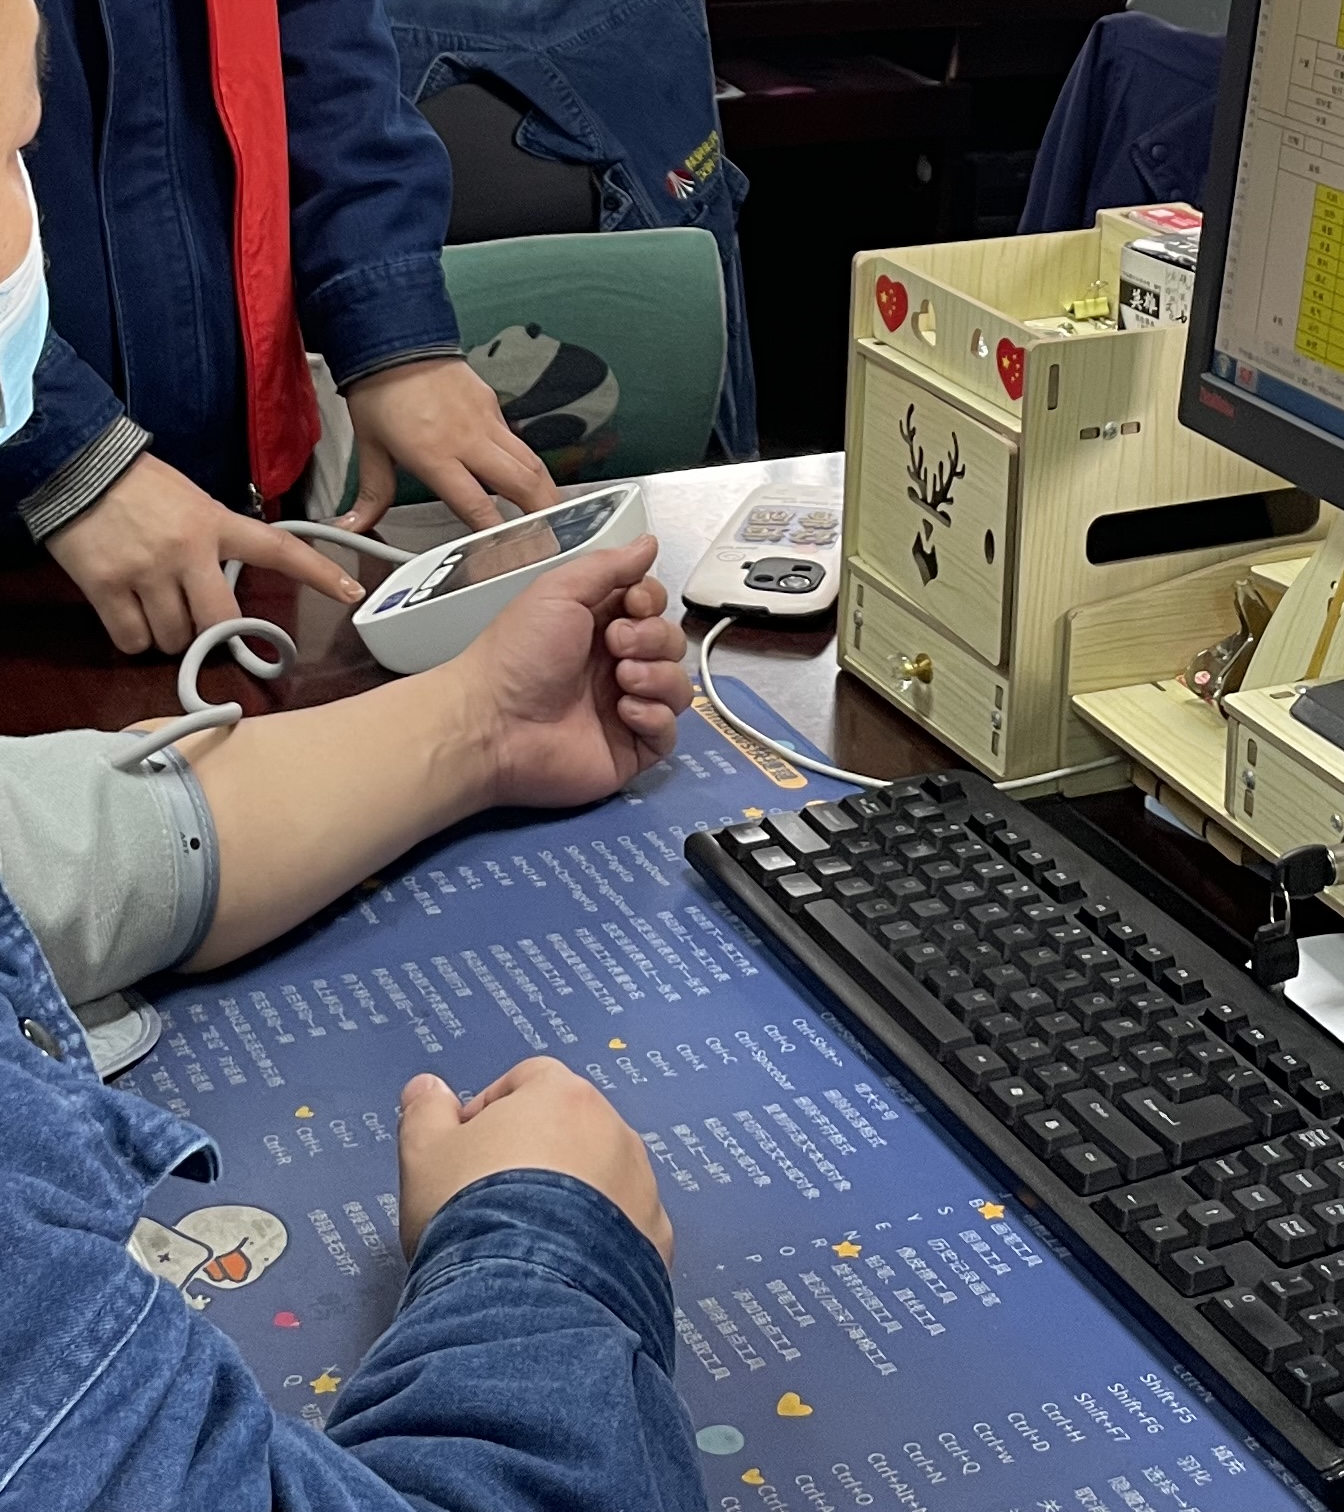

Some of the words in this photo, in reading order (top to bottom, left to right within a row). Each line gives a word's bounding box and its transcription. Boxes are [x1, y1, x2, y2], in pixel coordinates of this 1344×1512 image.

[587, 839, 637, 883] Ctrl+PageUp
[672, 1043, 710, 1071] Ctrl+X
[701, 1036, 740, 1064] Ctrl+C
[759, 1023, 797, 1053] Ctrl+Q
[582, 1063, 618, 1090] Ctrl+Y
[612, 1056, 650, 1084] Ctrl+Z
[642, 1049, 680, 1078] Ctrl+V
[730, 1030, 800, 1091] Ctrl+Spacebar
[293, 1126, 327, 1156] Ctrl+L
[326, 1119, 360, 1149] Ctrl+J
[359, 1111, 394, 1142] Ctrl+E
[259, 1134, 295, 1166] Ctrl+R
[305, 1208, 365, 1277] 使段落右对齐
[956, 1229, 1014, 1276] 图章工具
[987, 1221, 1046, 1267] 画笔工具
[924, 1237, 1004, 1307] 历史记录画笔
[763, 1279, 818, 1327] 钢笔工具
[827, 1262, 905, 1333] 旋转视图工具
[1070, 1392, 1131, 1443] Shift+F7
[1104, 1382, 1165, 1433] Shift+F6
[1136, 1373, 1197, 1423] Shift+F5
[1001, 1411, 1055, 1452] Ctrl+D
[1036, 1402, 1089, 1443] Ctrl+H
[897, 1441, 950, 1484] Ctrl+N
[932, 1431, 985, 1474] Ctrl+Q
[1171, 1455, 1215, 1485] 羽化
[1206, 1444, 1249, 1475] 填充
[826, 1462, 877, 1506] Ctrl+O
